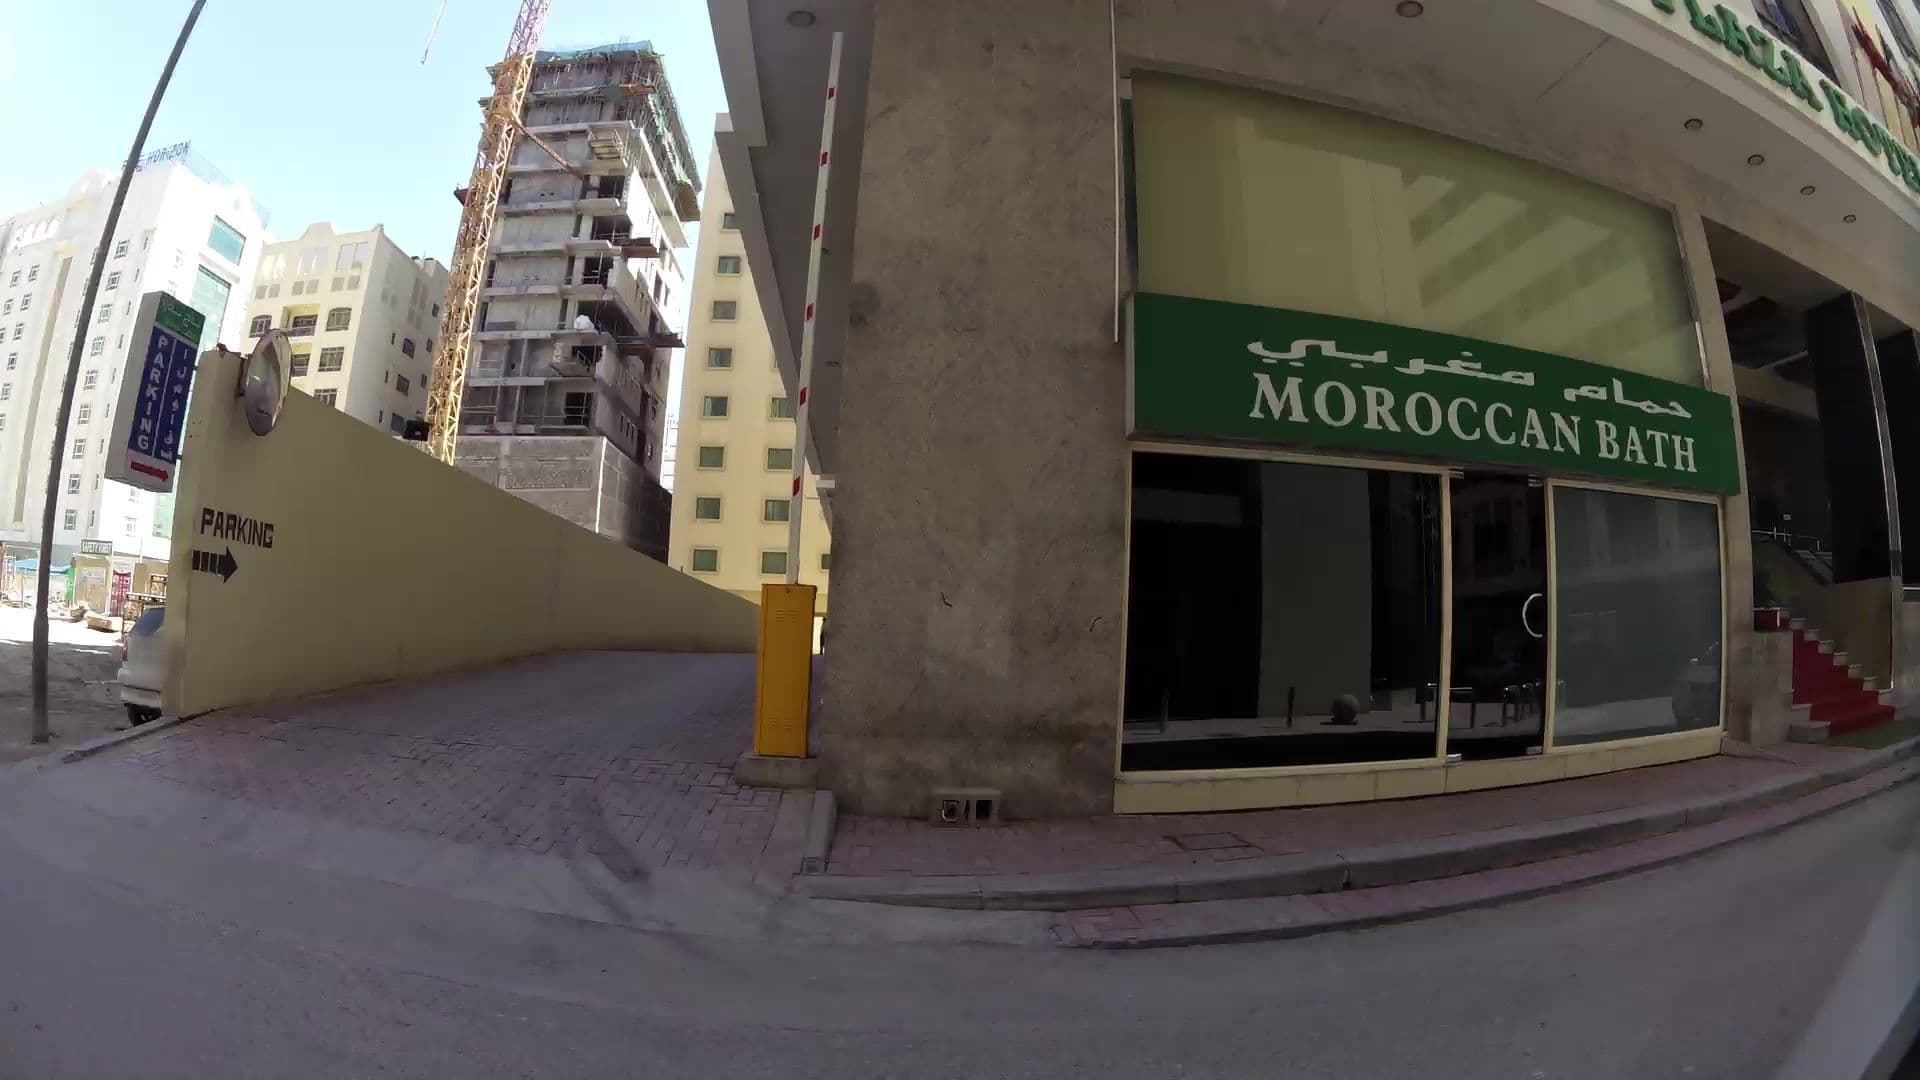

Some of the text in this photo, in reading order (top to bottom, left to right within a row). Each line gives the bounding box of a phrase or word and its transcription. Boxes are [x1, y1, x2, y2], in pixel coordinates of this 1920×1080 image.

[1652, 0, 1824, 112] LAZA
[137, 335, 169, 451] PARKING
[1247, 339, 1692, 418] حمام مغربي
[1249, 373, 1698, 473] MOROCCAN BATH
[200, 507, 274, 549] PARKING
